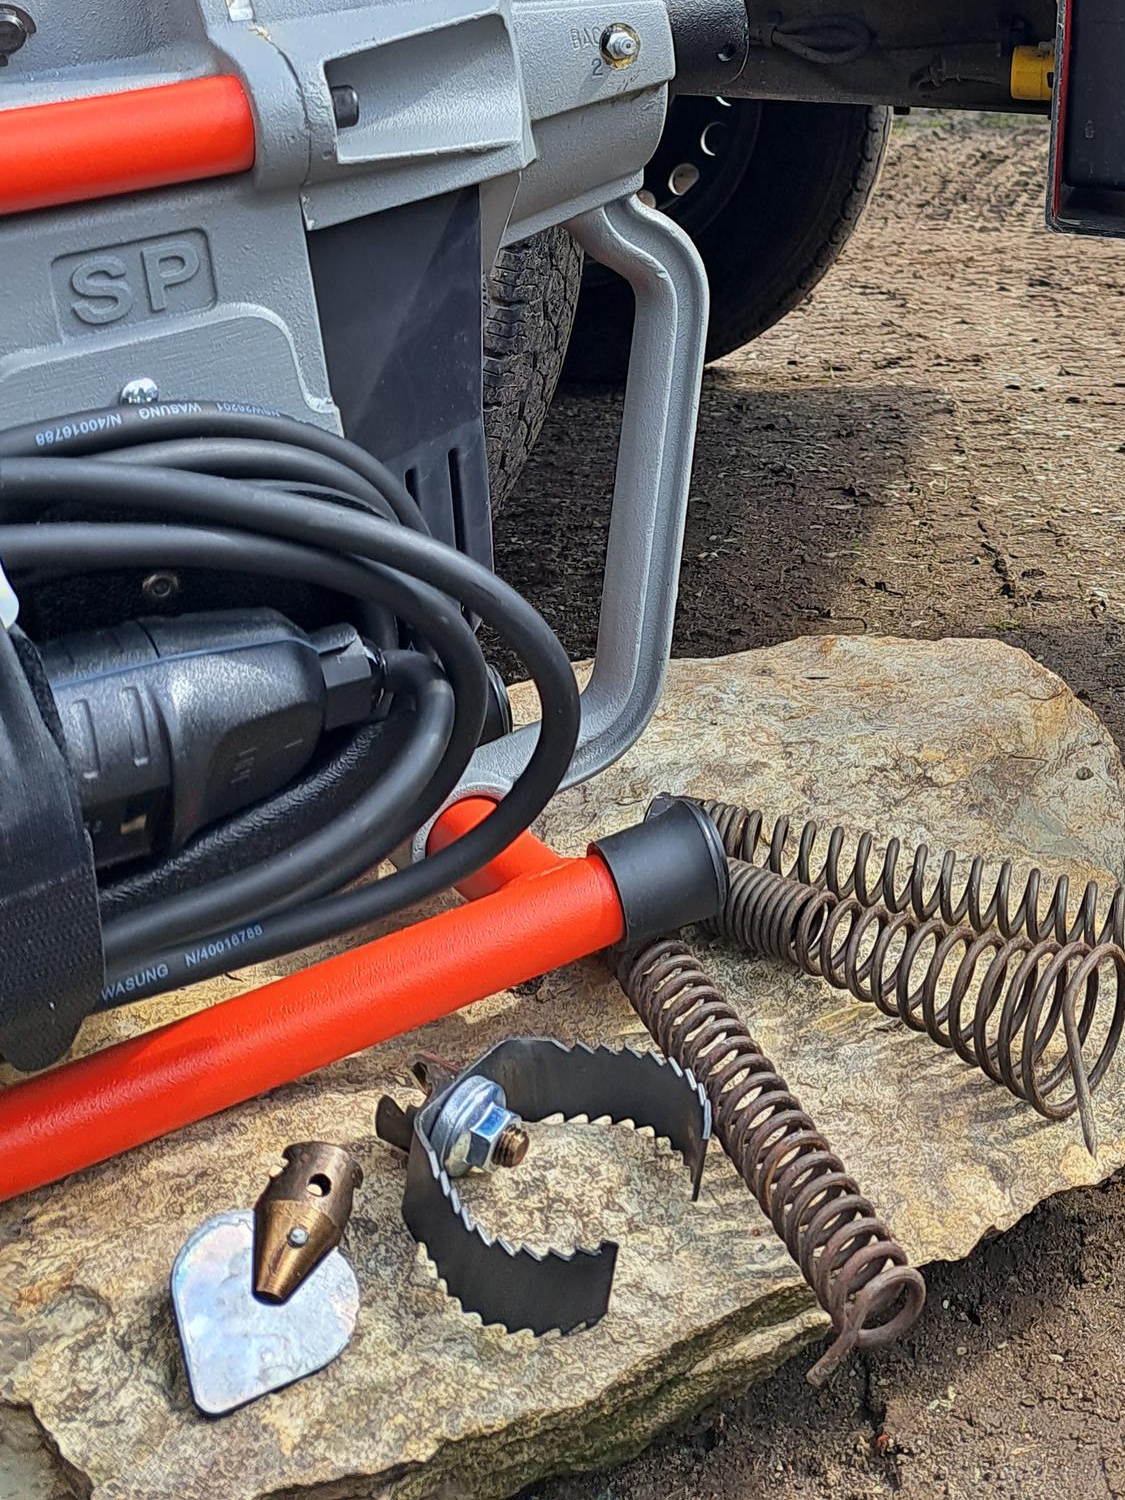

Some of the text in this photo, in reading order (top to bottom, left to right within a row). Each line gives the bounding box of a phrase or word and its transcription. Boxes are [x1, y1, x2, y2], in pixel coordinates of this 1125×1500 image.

[70, 240, 201, 328] SP
[138, 402, 203, 421] WASUNG
[101, 963, 169, 1002] WASUNG
